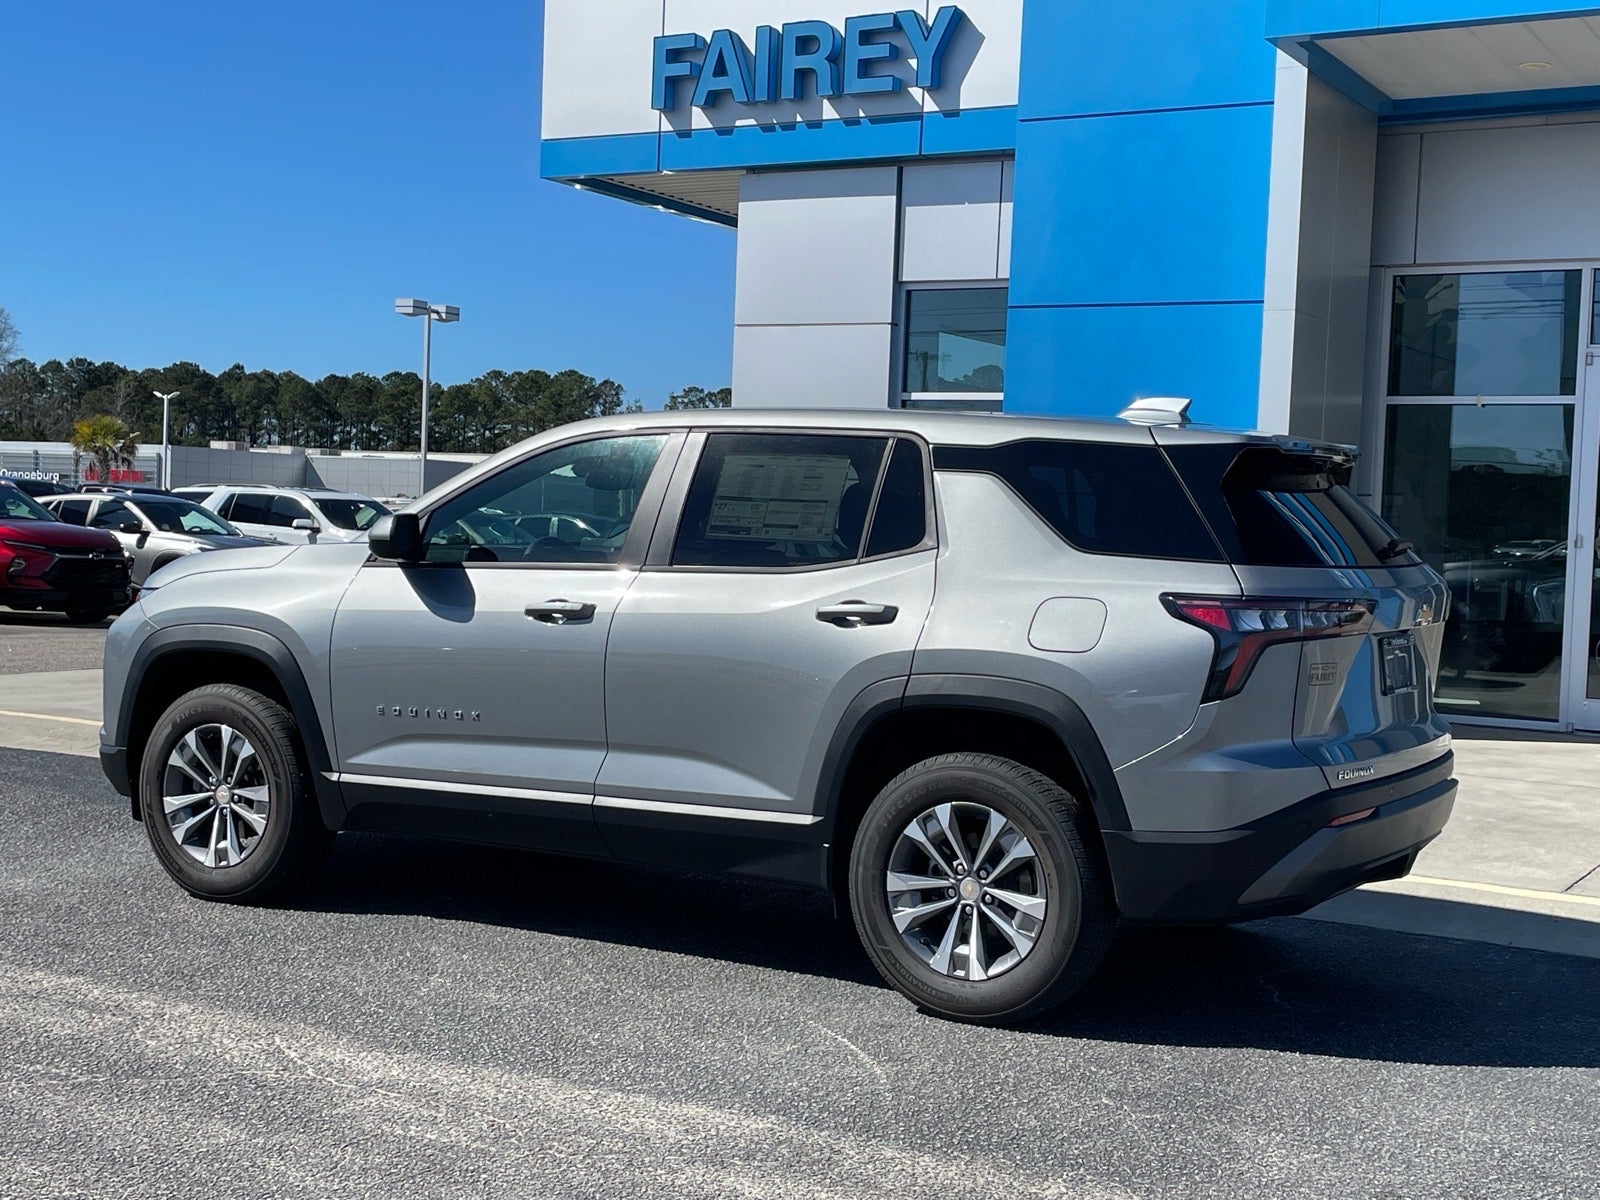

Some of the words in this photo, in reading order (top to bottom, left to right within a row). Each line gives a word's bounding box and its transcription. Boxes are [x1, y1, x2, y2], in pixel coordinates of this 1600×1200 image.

[651, 5, 961, 111] FAIREY
[0, 468, 59, 482] Orangeburg
[84, 468, 143, 482] NISAN
[376, 705, 480, 720] EQUINOX
[1337, 765, 1374, 780] EQUINOX
